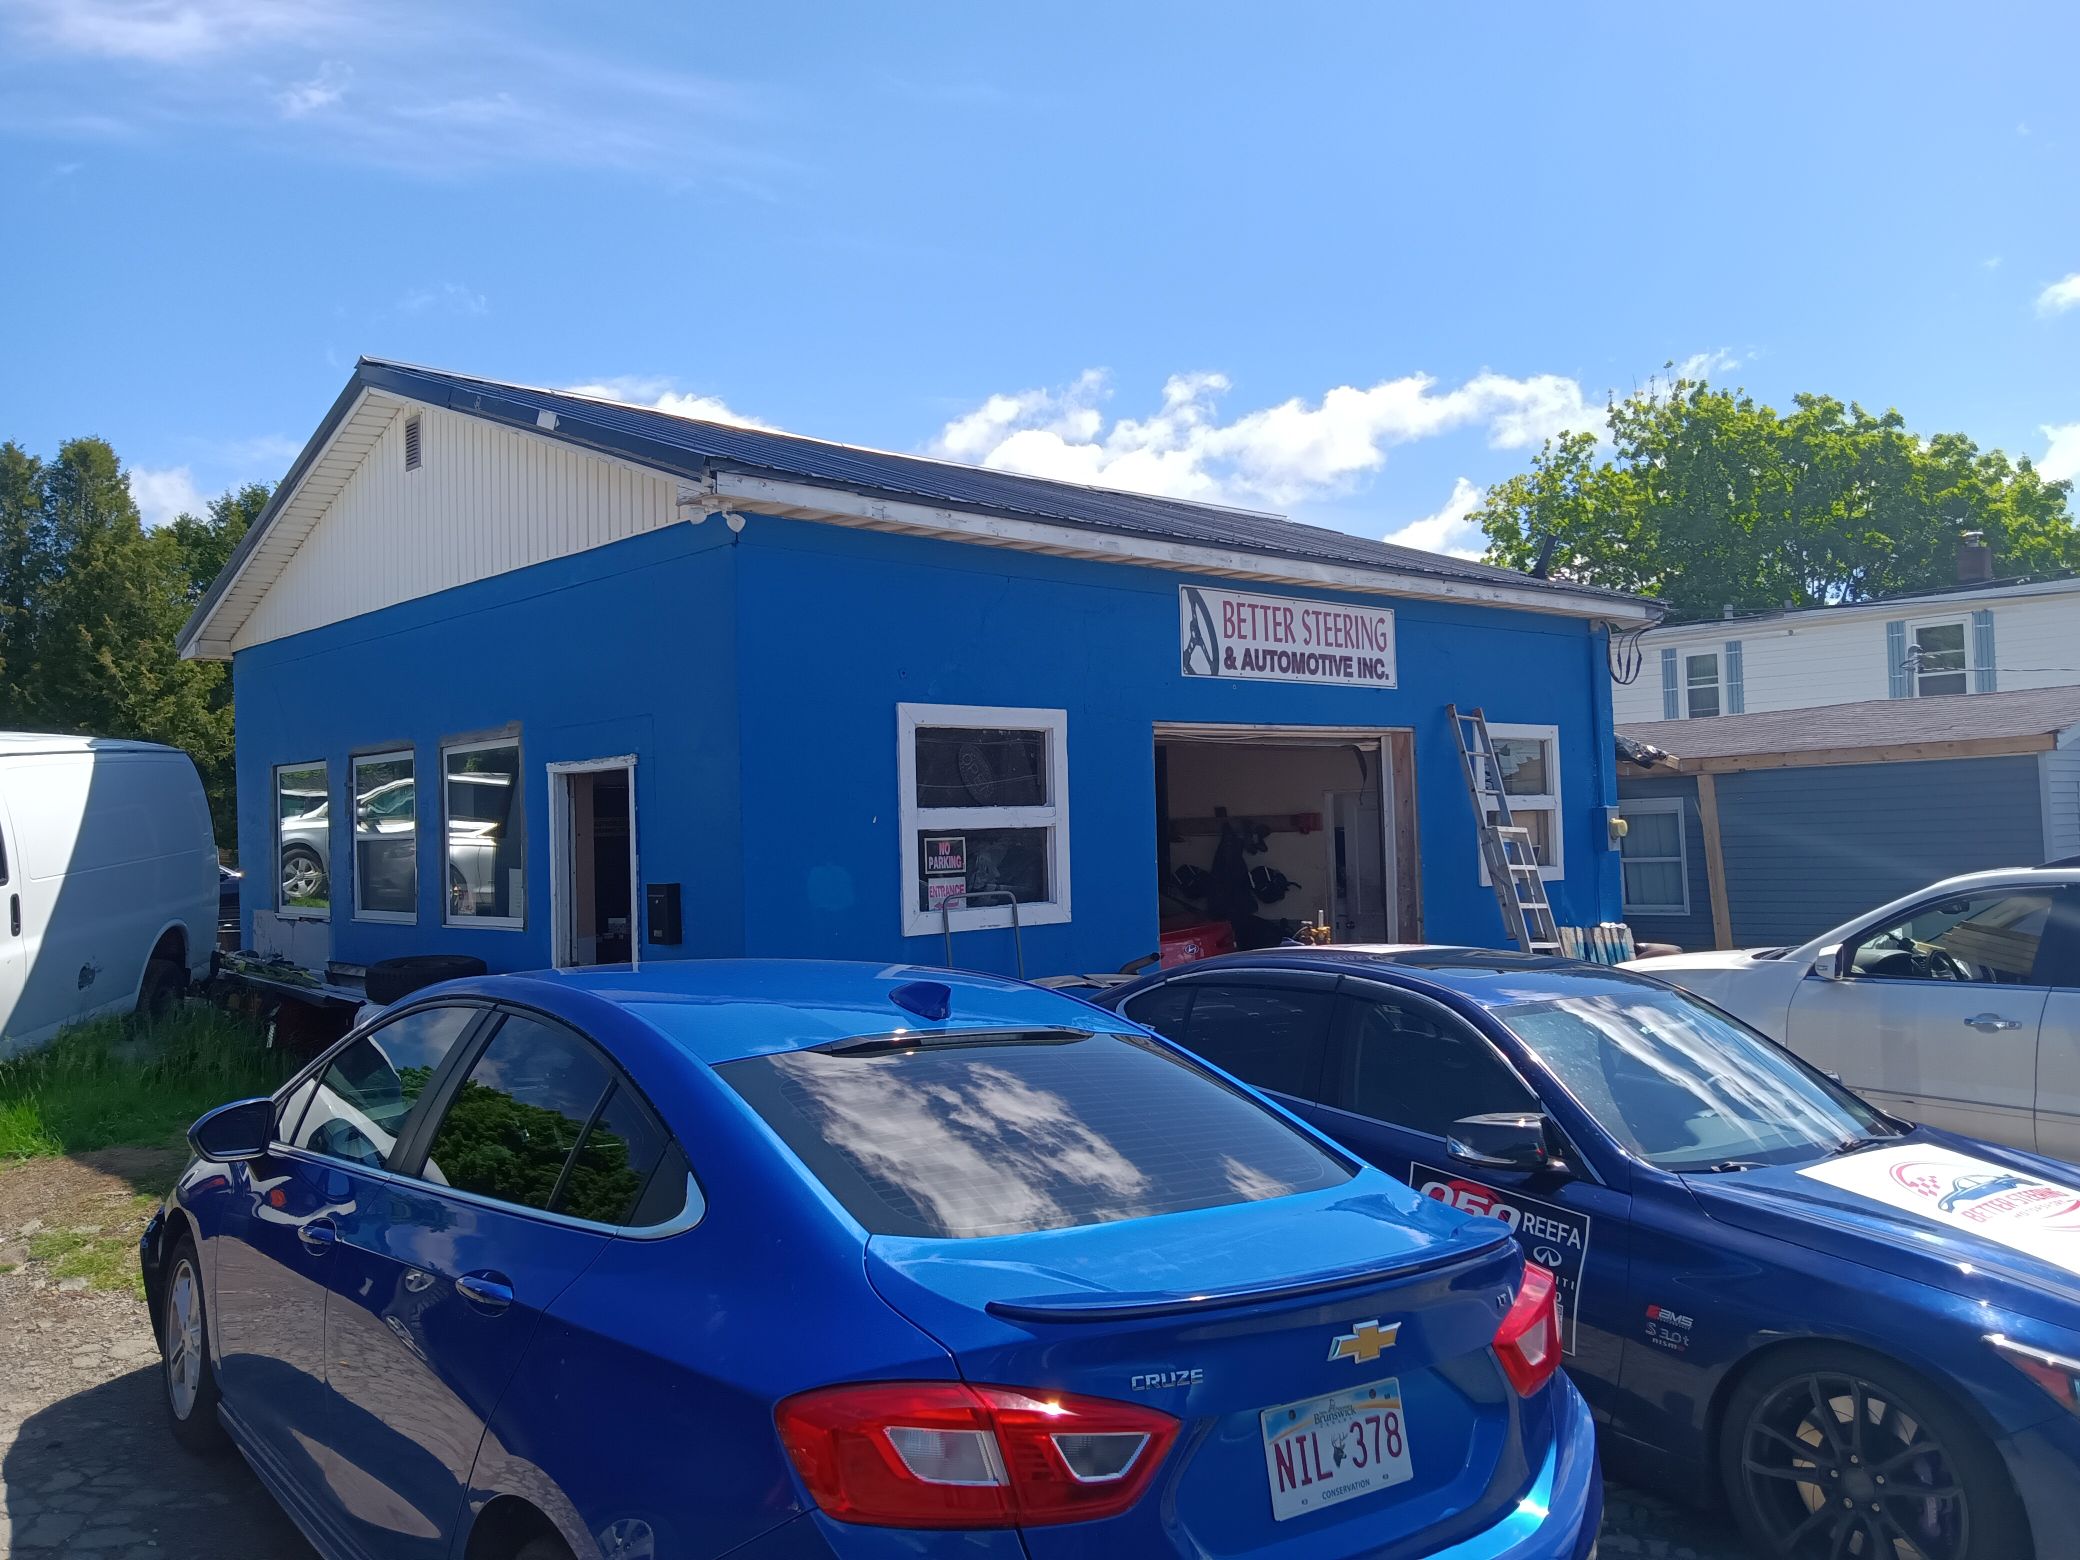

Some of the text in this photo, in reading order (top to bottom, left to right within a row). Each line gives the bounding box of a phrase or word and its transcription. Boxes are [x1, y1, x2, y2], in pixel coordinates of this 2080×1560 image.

[1222, 600, 1296, 644] BETTER
[1302, 609, 1388, 652] STEERING
[1224, 646, 1390, 680] & AUTOMOTIVE INC.
[939, 842, 951, 855] NO
[928, 855, 962, 870] PARKING
[929, 884, 965, 898] ENTRANCE
[1960, 1197, 2018, 1222] BETTER
[1522, 1212, 1582, 1250] REEFA
[1131, 1368, 1203, 1391] CRUZE
[1314, 1405, 1357, 1424] Brunswick
[1274, 1411, 1403, 1493] NIL 378
[1322, 1479, 1370, 1500] CONSERVATION
